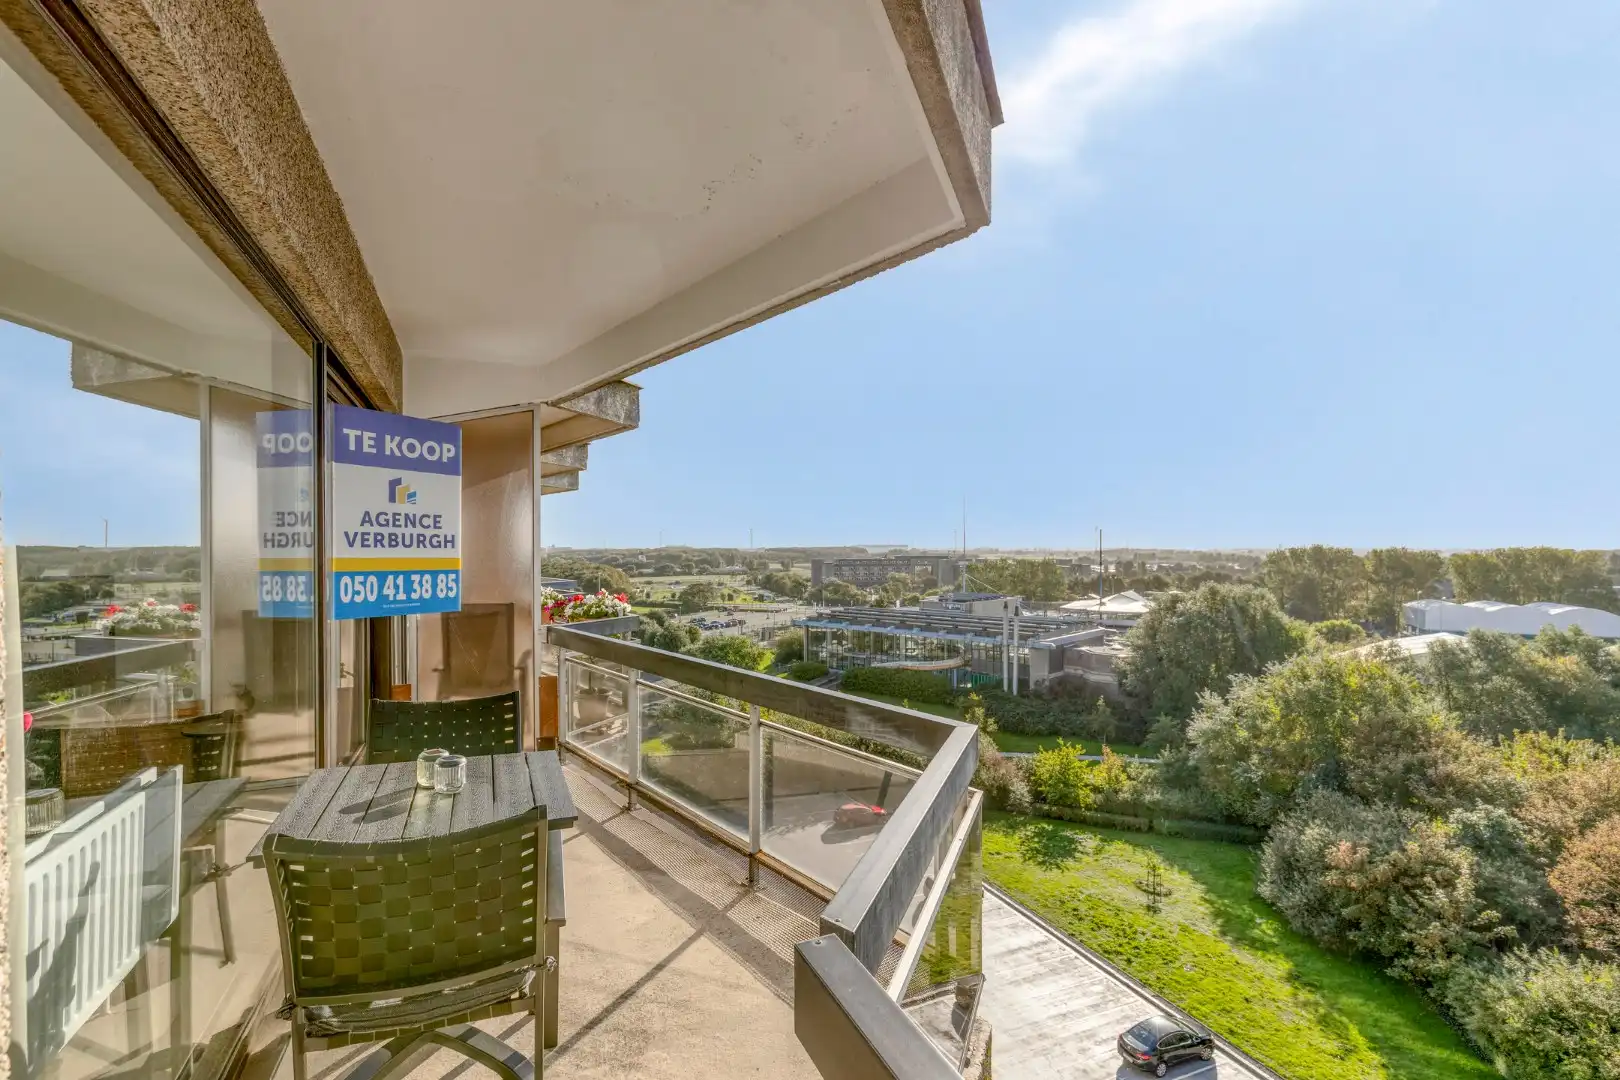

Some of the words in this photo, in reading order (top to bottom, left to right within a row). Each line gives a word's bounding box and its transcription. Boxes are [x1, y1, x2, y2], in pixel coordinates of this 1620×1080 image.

[343, 428, 377, 454] TE
[385, 434, 456, 463] KOOP
[360, 510, 443, 530] AGENCE
[344, 531, 456, 549] VERBURGH
[340, 575, 379, 603] 050
[382, 574, 407, 601] 41
[410, 573, 432, 600] 38
[436, 573, 457, 599] 85
